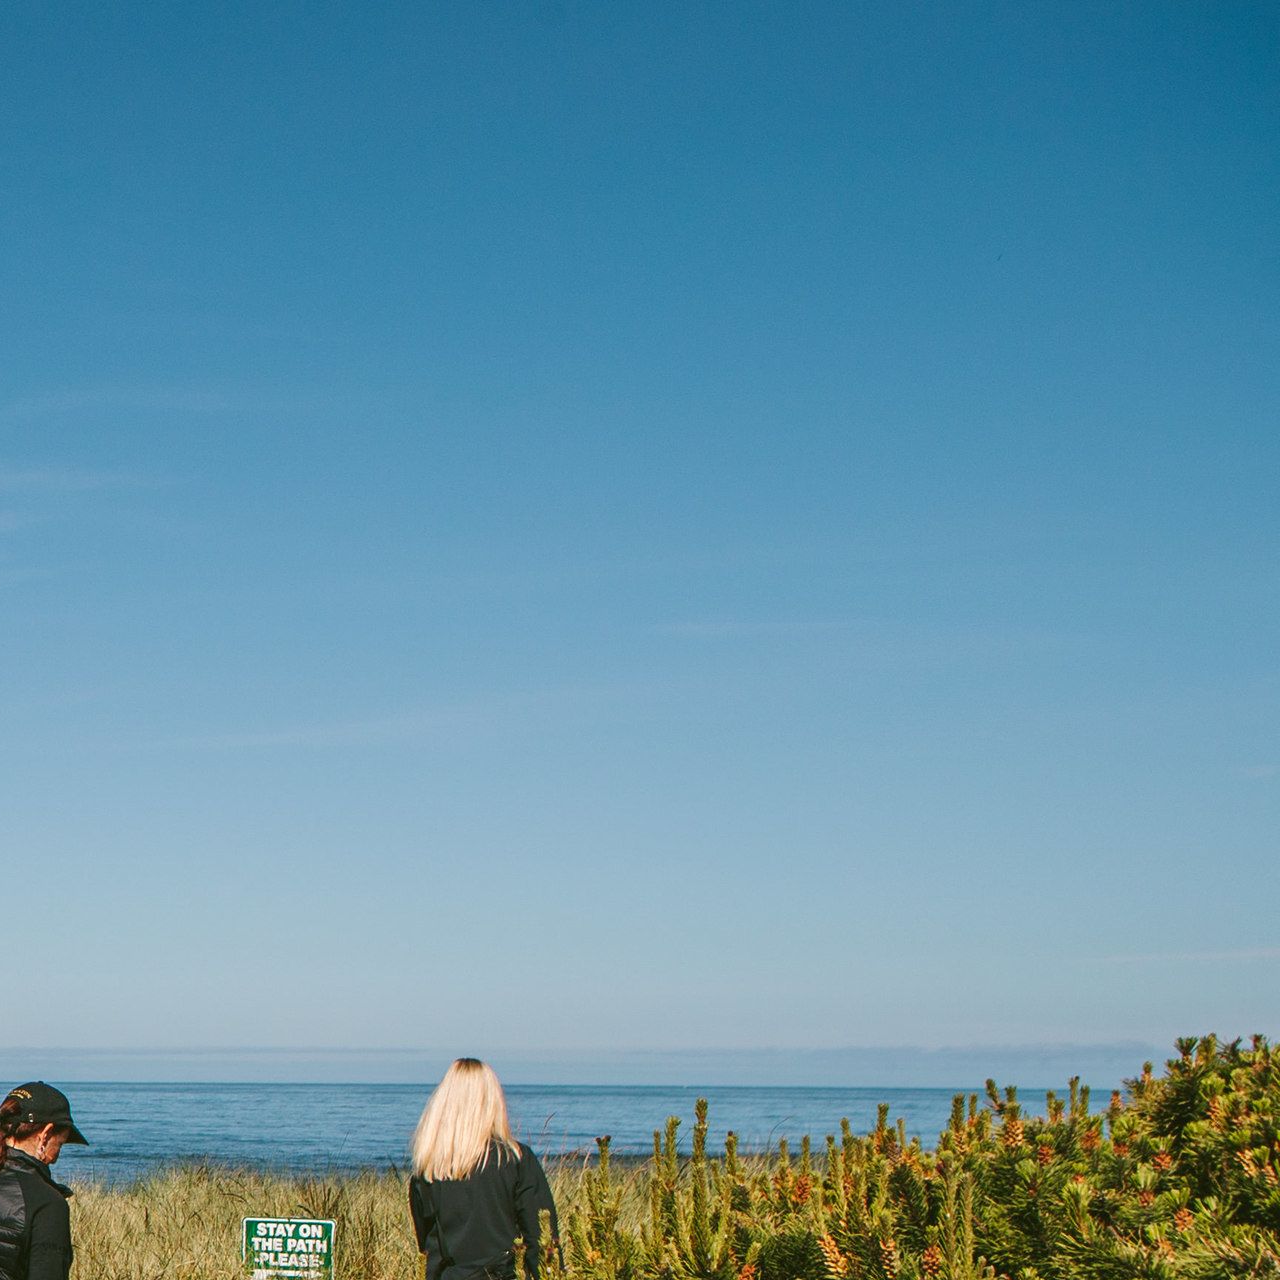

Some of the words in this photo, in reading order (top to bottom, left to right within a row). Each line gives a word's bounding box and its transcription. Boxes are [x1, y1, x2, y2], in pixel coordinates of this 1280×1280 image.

[256, 1222, 296, 1237] STAY
[299, 1224, 323, 1238] ON
[251, 1237, 283, 1252] THE
[287, 1238, 327, 1253] PATH
